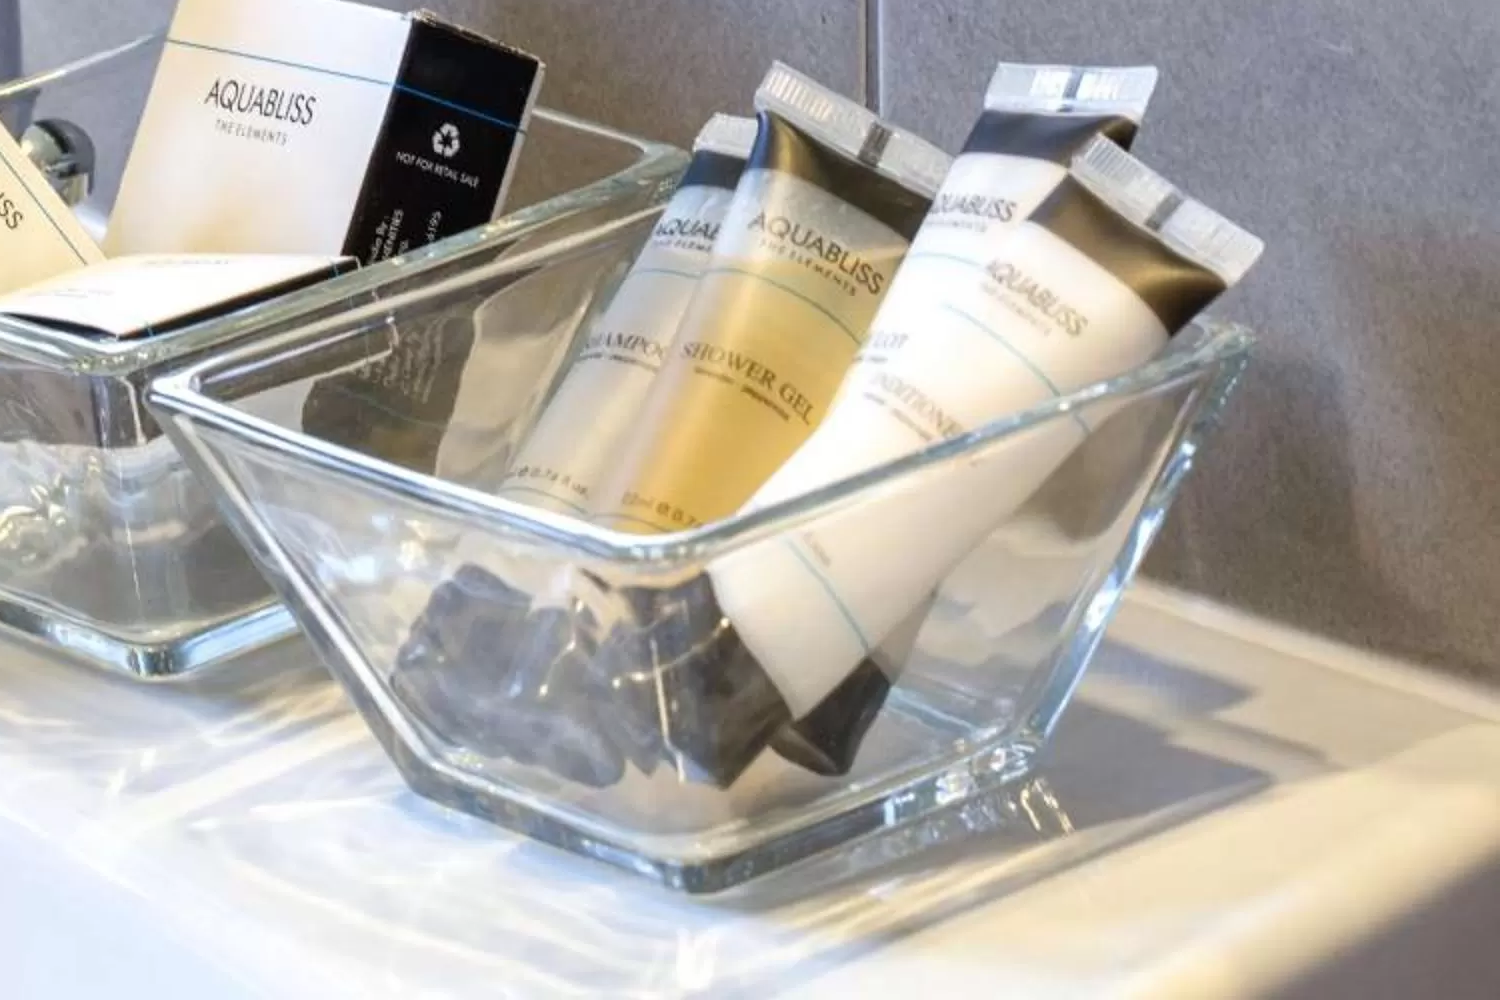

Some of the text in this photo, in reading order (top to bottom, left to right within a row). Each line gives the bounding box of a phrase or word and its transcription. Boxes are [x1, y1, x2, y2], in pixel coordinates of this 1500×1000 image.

[202, 77, 318, 126] AQUABLISS
[396, 151, 481, 189] NOT FOR RETAIL SALE
[747, 210, 885, 296] AQUABLISS
[680, 341, 777, 392] SHOWER
[778, 381, 815, 426] GEL
